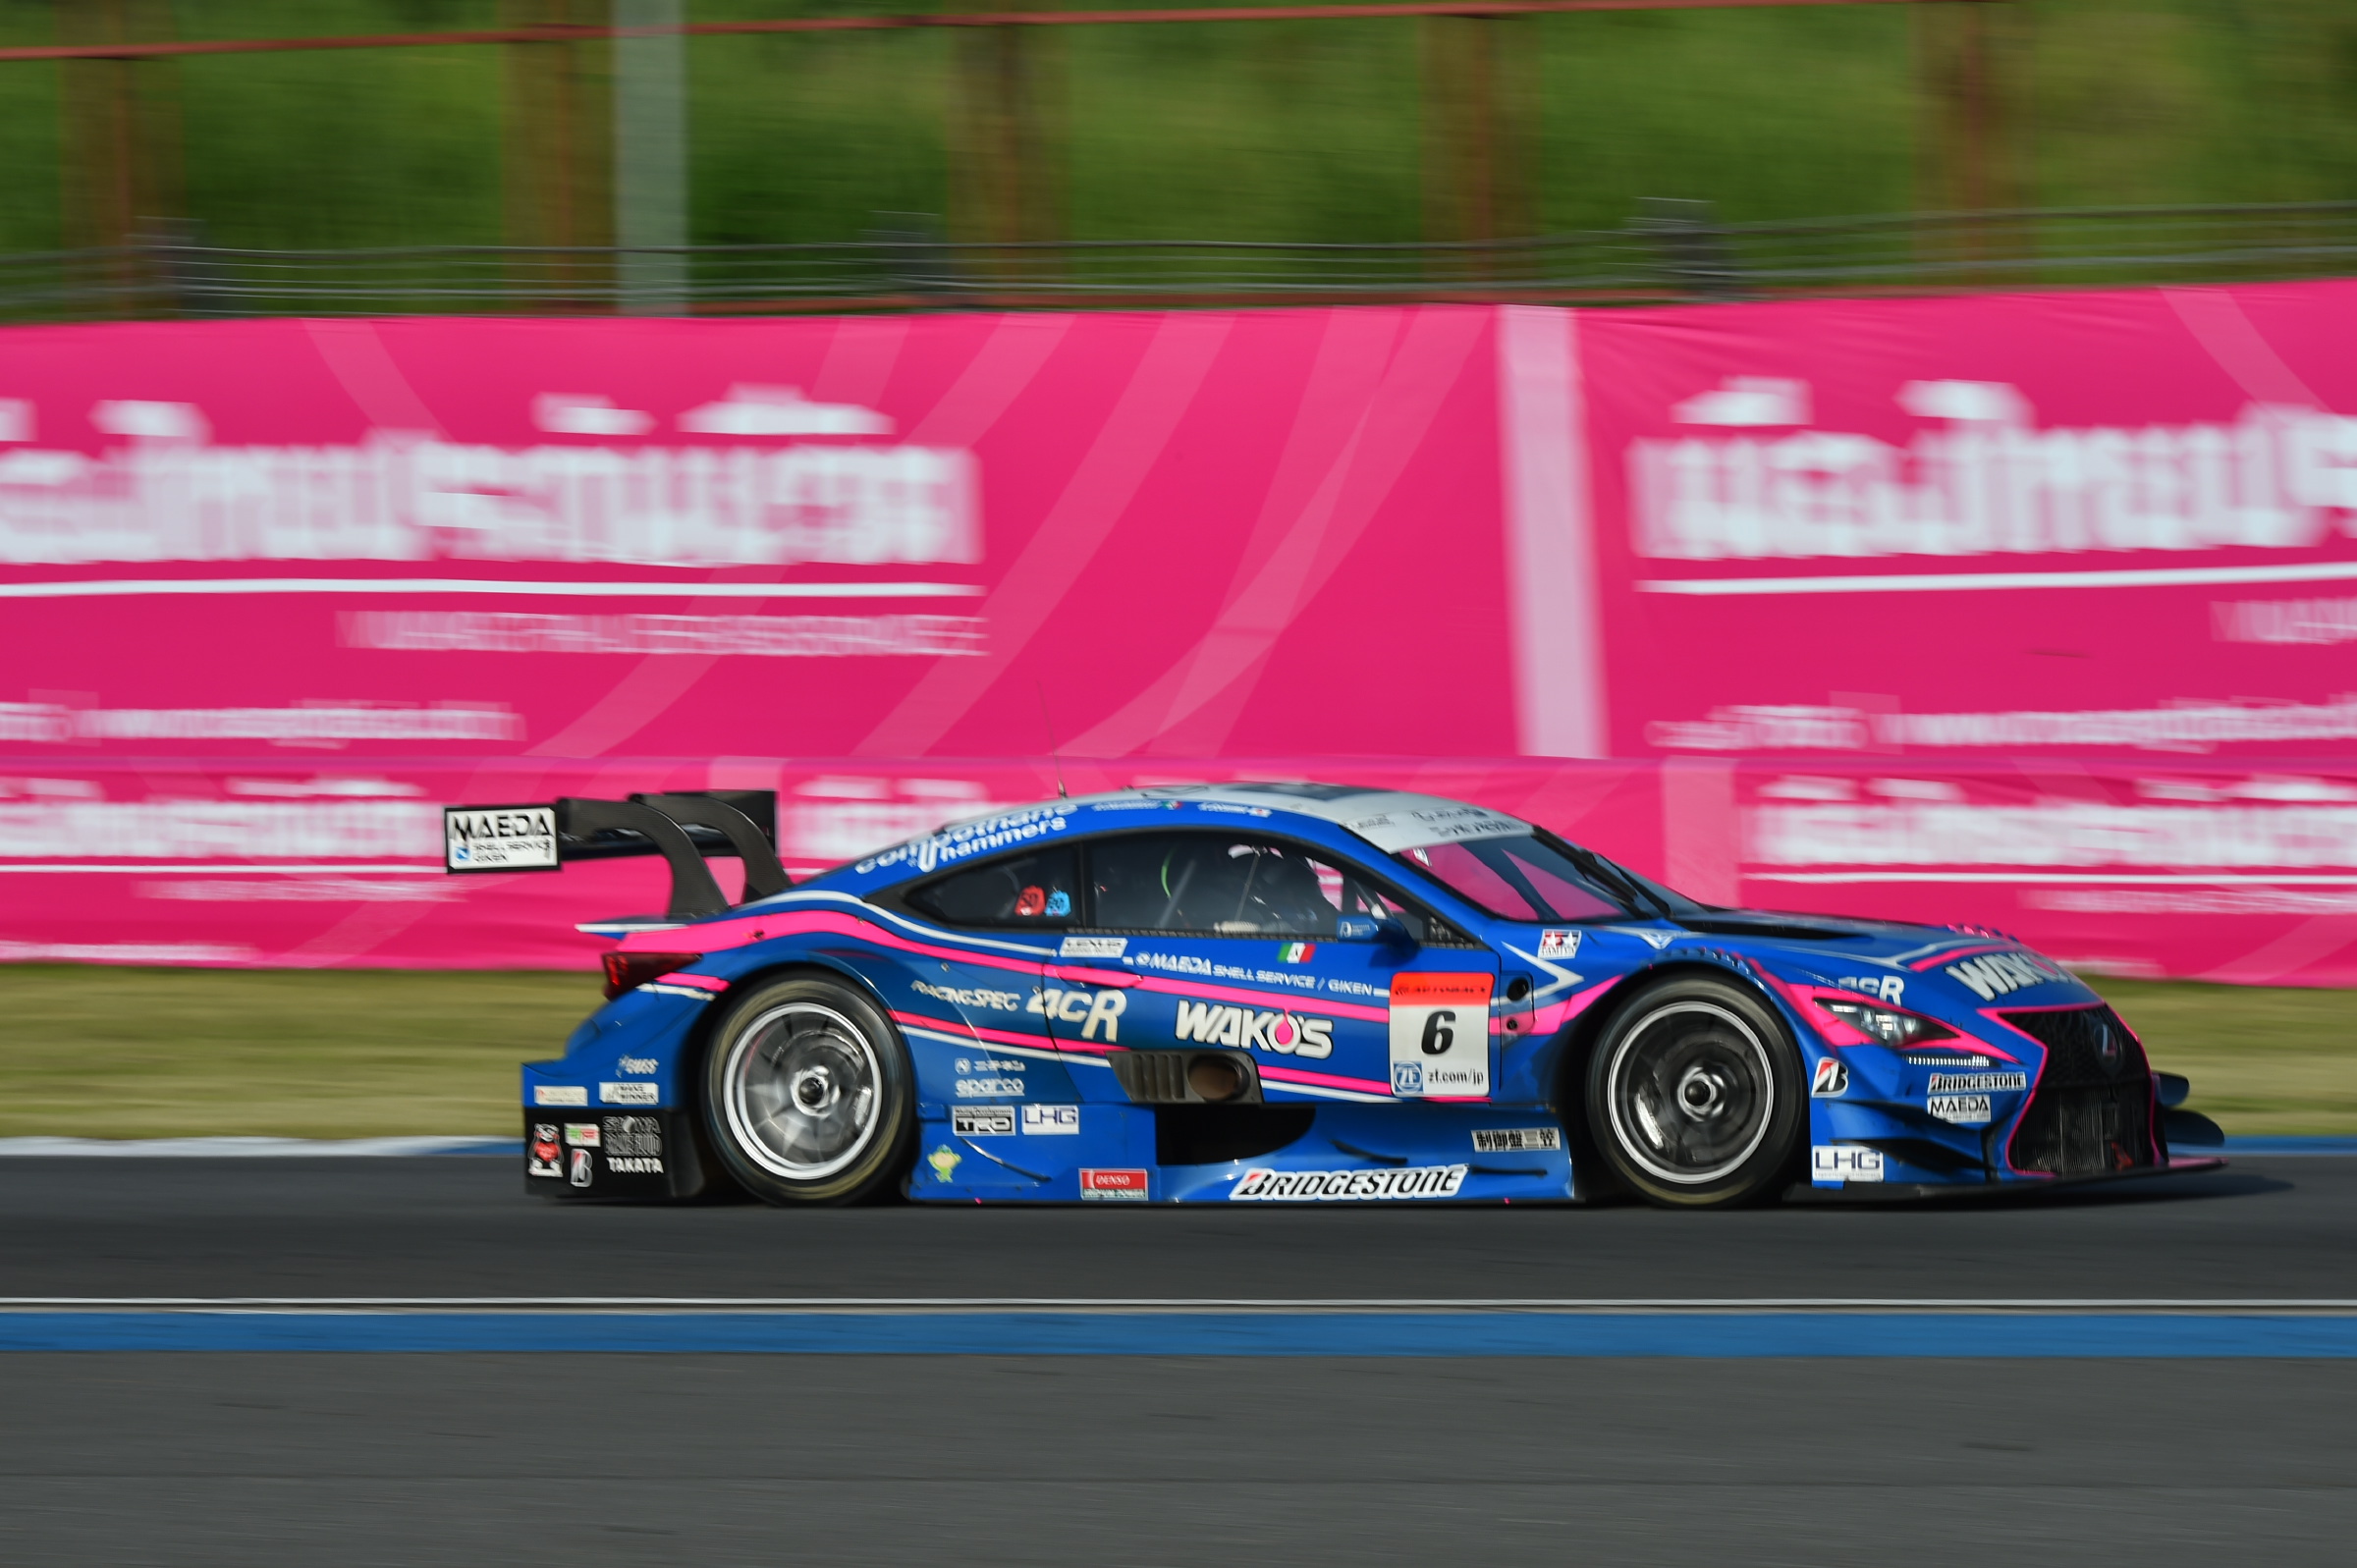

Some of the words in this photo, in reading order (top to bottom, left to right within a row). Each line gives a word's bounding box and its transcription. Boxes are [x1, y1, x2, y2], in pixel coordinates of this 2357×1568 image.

[450, 813, 556, 841] MAEDA
[938, 816, 1068, 863] hammers
[1149, 952, 1212, 976] MAEDA
[1213, 964, 1254, 982] SHELL
[1255, 969, 1316, 990] SERVICE
[1328, 979, 1373, 996] GIKEN
[1025, 988, 1127, 1043] 4CR
[1176, 1000, 1333, 1059] WAKO'S
[1421, 1009, 1457, 1055] 6
[1428, 1068, 1484, 1086] zf.com/jp
[1929, 1072, 2026, 1093] BRIDGESTONE
[956, 1078, 1025, 1098] sparco
[1024, 1107, 1078, 1124] LHG
[1930, 1097, 1990, 1115] MAEDA
[956, 1117, 1012, 1135] TRD
[607, 1157, 664, 1173] TAKATA
[1815, 1150, 1881, 1169] LHG
[1096, 1174, 1130, 1186] DENSO
[1233, 1166, 1465, 1198] BRIDGESTONE
